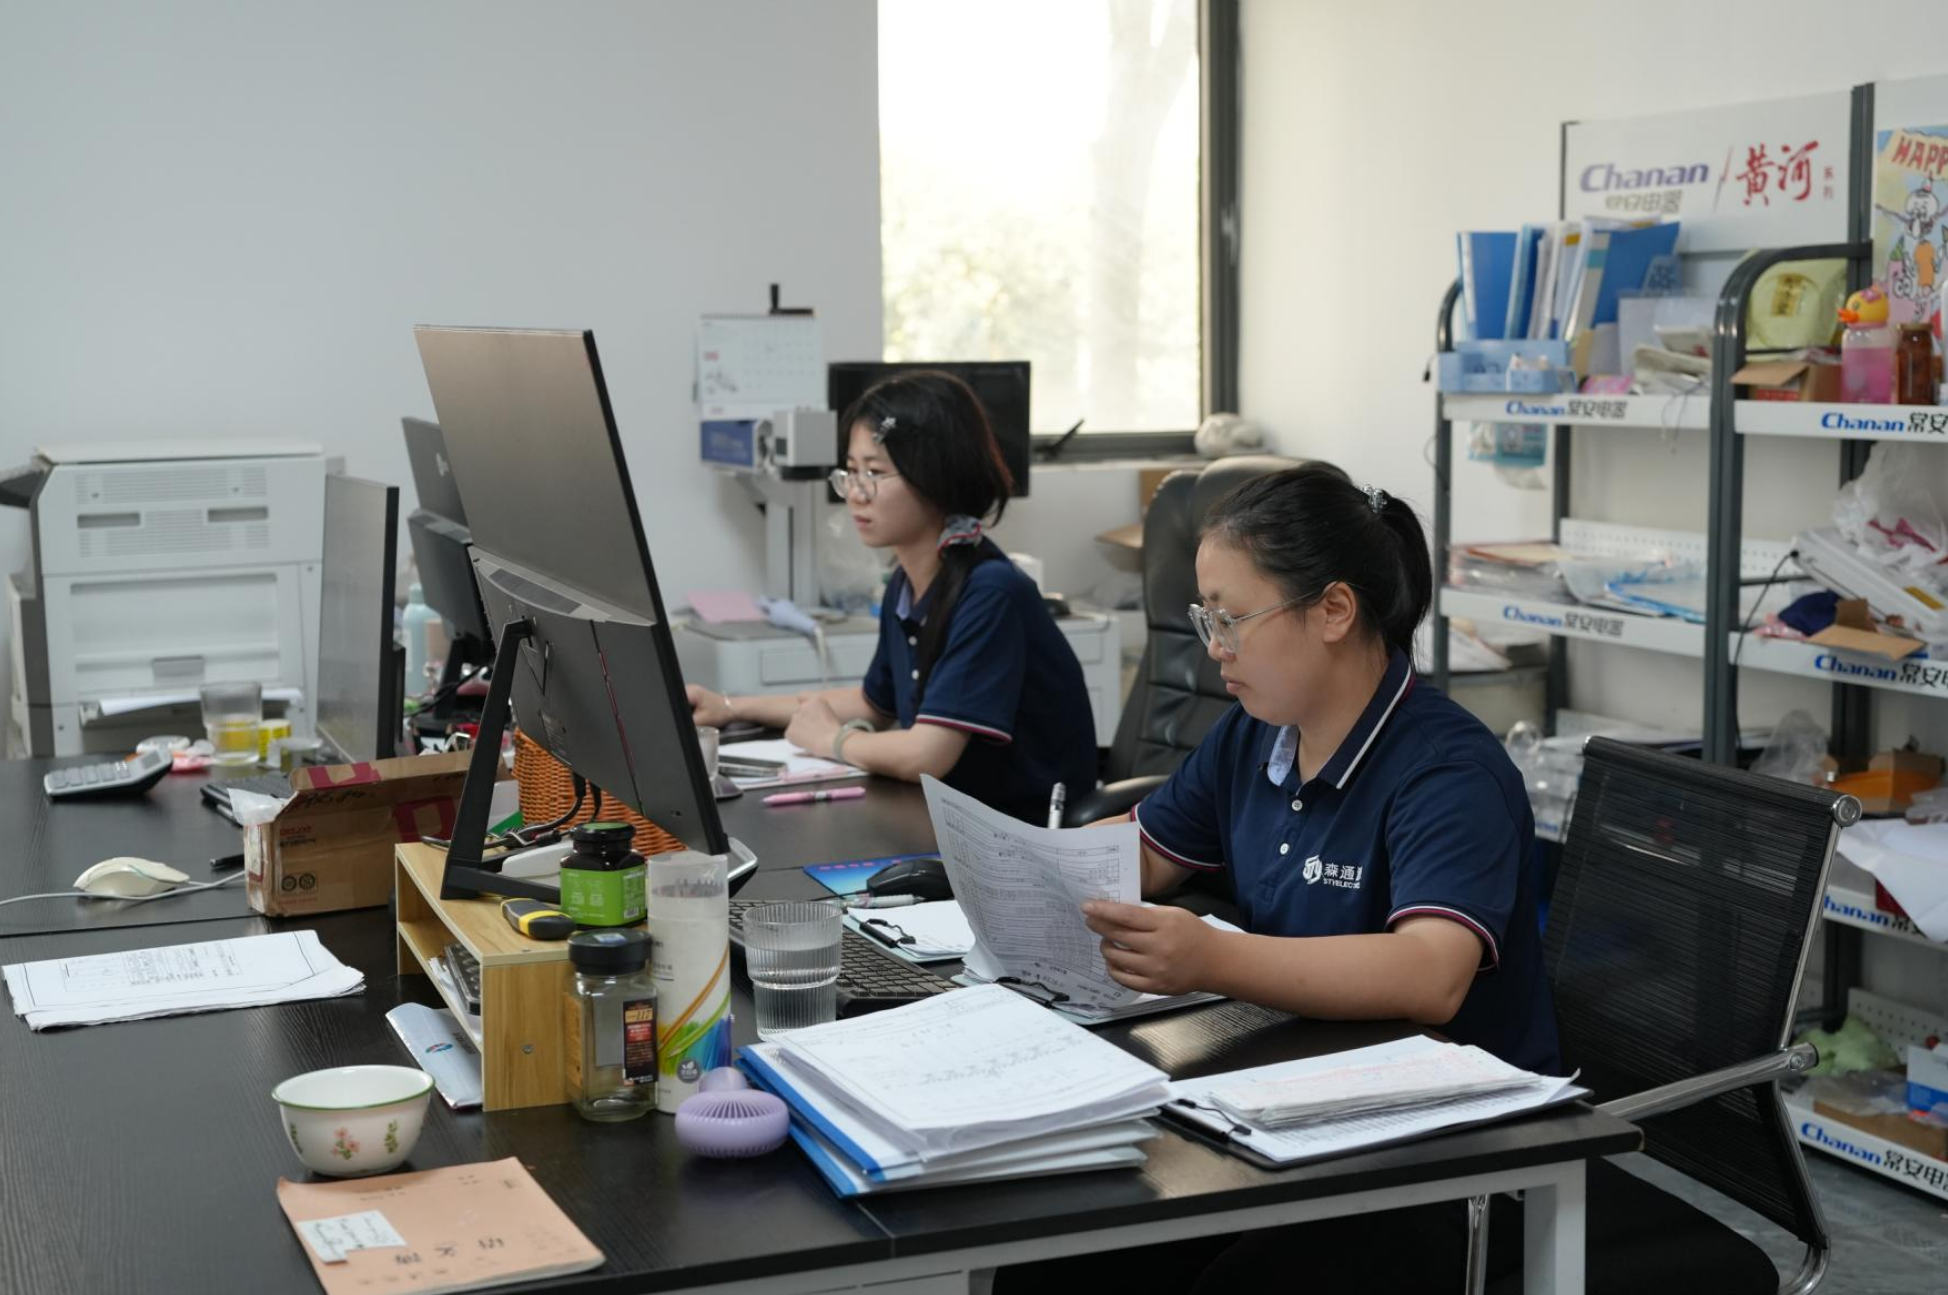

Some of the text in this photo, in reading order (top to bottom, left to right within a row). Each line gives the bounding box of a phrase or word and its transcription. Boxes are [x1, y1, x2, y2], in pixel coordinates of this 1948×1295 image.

[1580, 163, 1709, 193] Chanan
[1736, 140, 1818, 206] 黄河
[1506, 401, 1565, 417] Chanan
[1821, 411, 1905, 432] Chanan
[1503, 605, 1564, 628] Chanan
[1814, 654, 1897, 681] Chanan
[1823, 895, 1890, 927] hanan
[1801, 1122, 1881, 1165] Chanan
